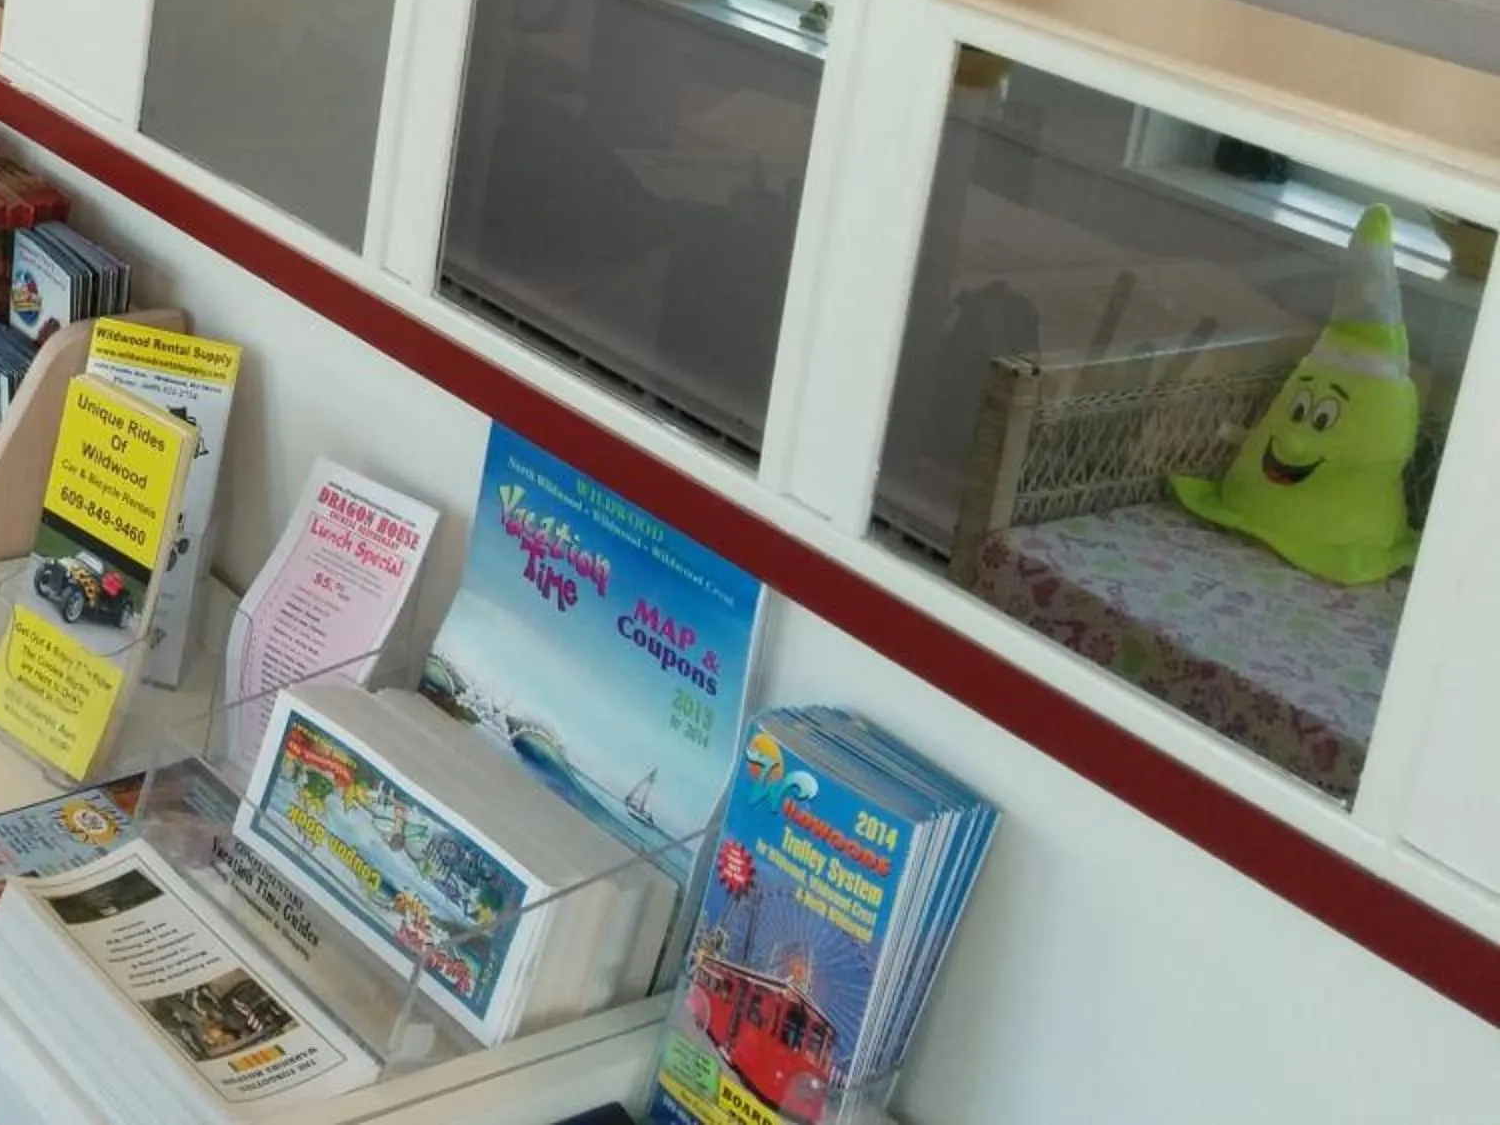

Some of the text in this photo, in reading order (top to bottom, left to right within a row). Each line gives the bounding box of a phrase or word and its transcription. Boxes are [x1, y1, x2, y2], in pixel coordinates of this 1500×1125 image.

[96, 328, 234, 367] Wildwood Rental Supply
[77, 394, 166, 452] Unique Rides
[110, 434, 128, 454] Of
[82, 442, 148, 490] Wildwood
[316, 485, 376, 525] DRAGON
[377, 513, 421, 551] HOUSE
[498, 483, 612, 599] Vacation
[575, 477, 665, 543] WILDWOOD
[309, 517, 354, 553] Lunch
[354, 540, 406, 578] Special
[616, 615, 719, 698] Coupons
[632, 598, 721, 673] MAP &
[287, 805, 383, 893] Coupon Book
[854, 809, 900, 851] 2014
[255, 876, 282, 912] Time
[781, 824, 828, 877] Trolley
[827, 857, 885, 908] System
